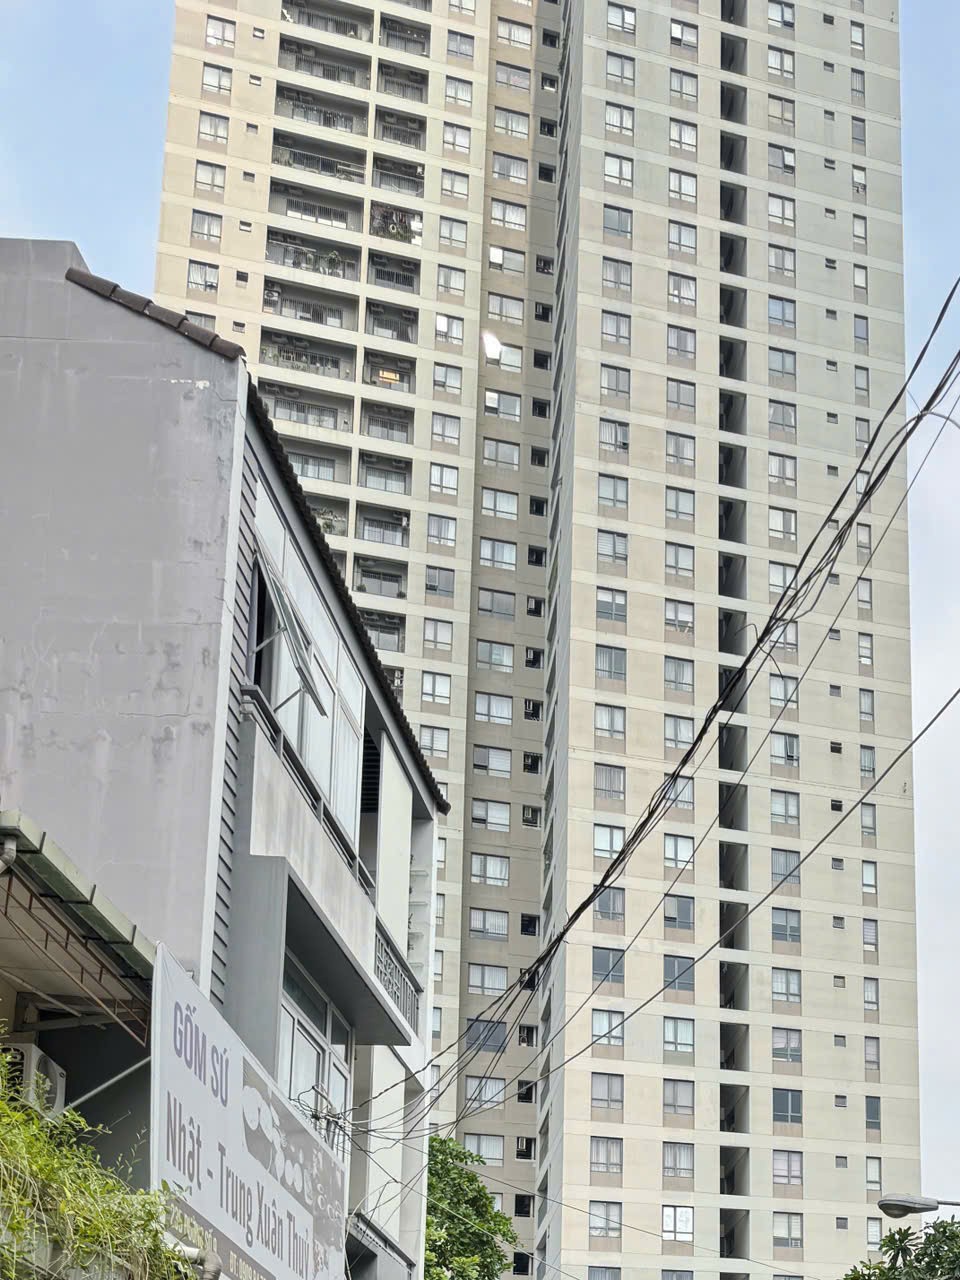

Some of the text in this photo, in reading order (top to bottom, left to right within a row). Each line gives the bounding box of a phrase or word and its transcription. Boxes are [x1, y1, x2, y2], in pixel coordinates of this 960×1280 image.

[210, 1044, 229, 1108] SỨ
[218, 1141, 254, 1248] Trung
[256, 1180, 284, 1261] Xuân
